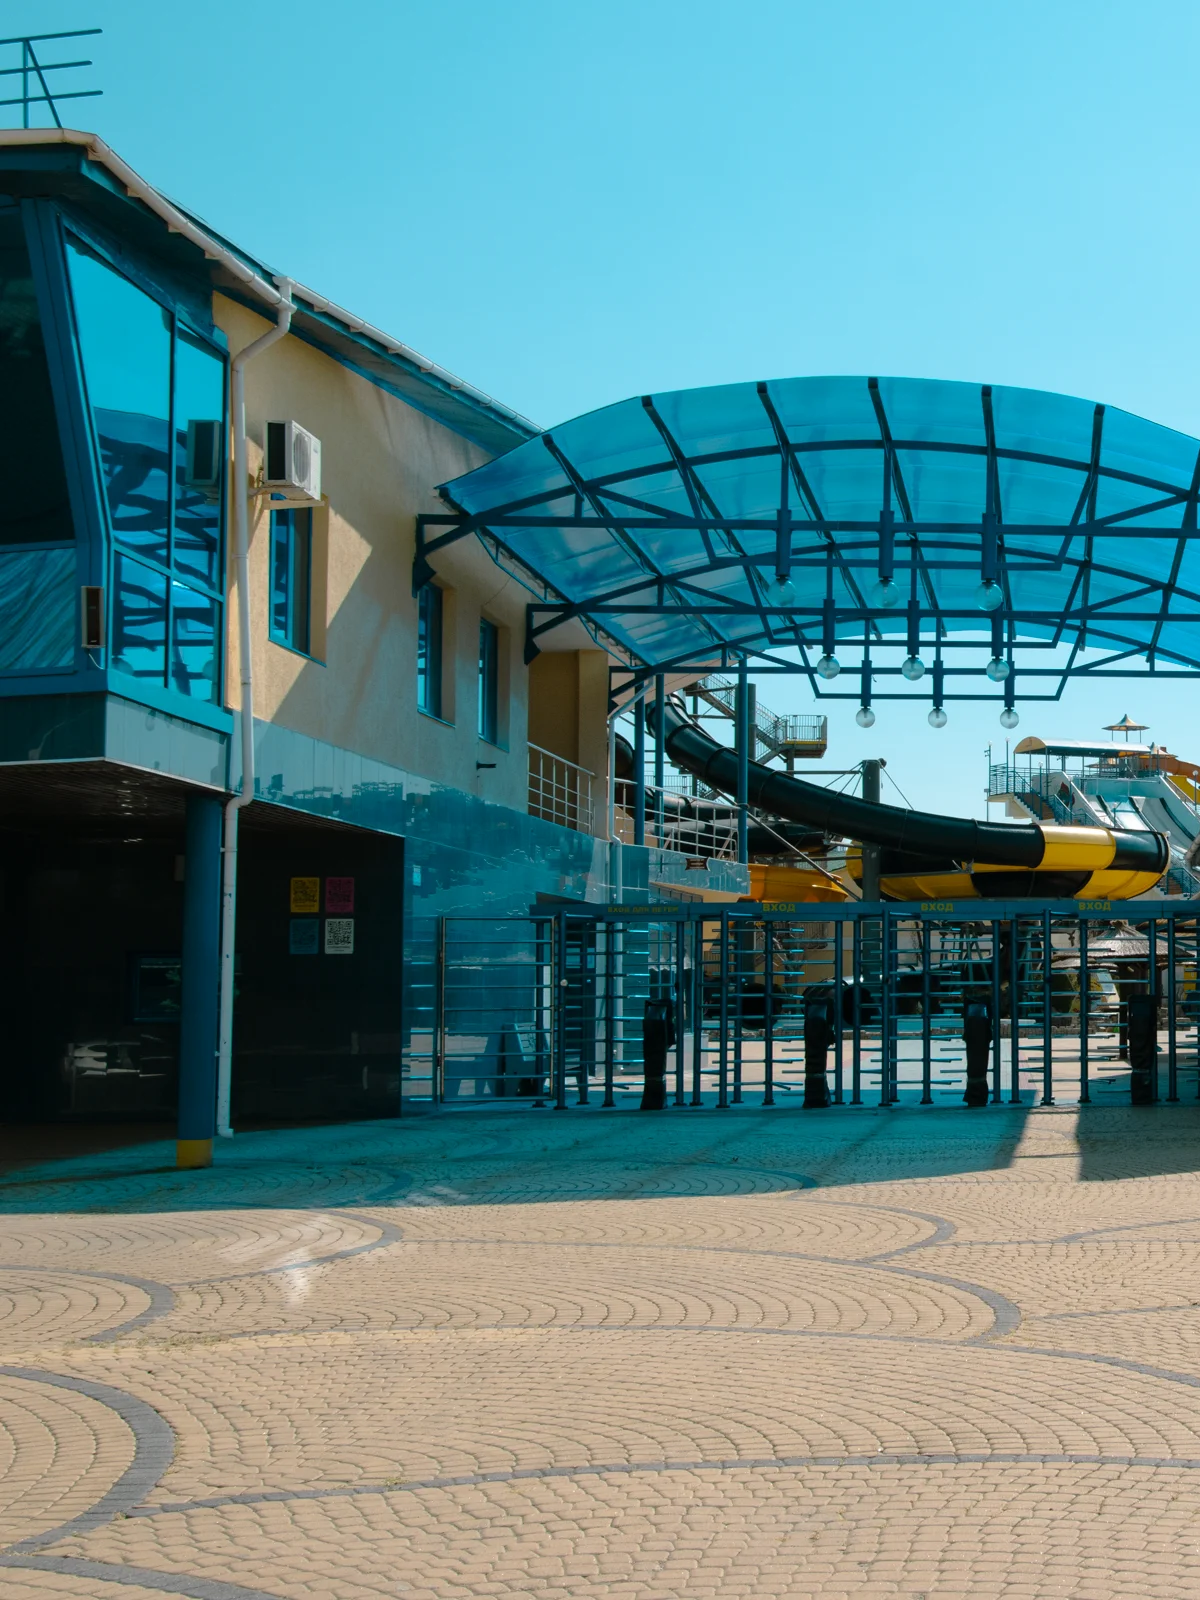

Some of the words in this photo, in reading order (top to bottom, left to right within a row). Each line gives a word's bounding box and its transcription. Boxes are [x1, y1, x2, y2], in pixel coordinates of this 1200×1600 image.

[762, 903, 796, 913] ВХОД
[920, 902, 954, 913] ВХОД
[1078, 901, 1112, 912] ВХОД
